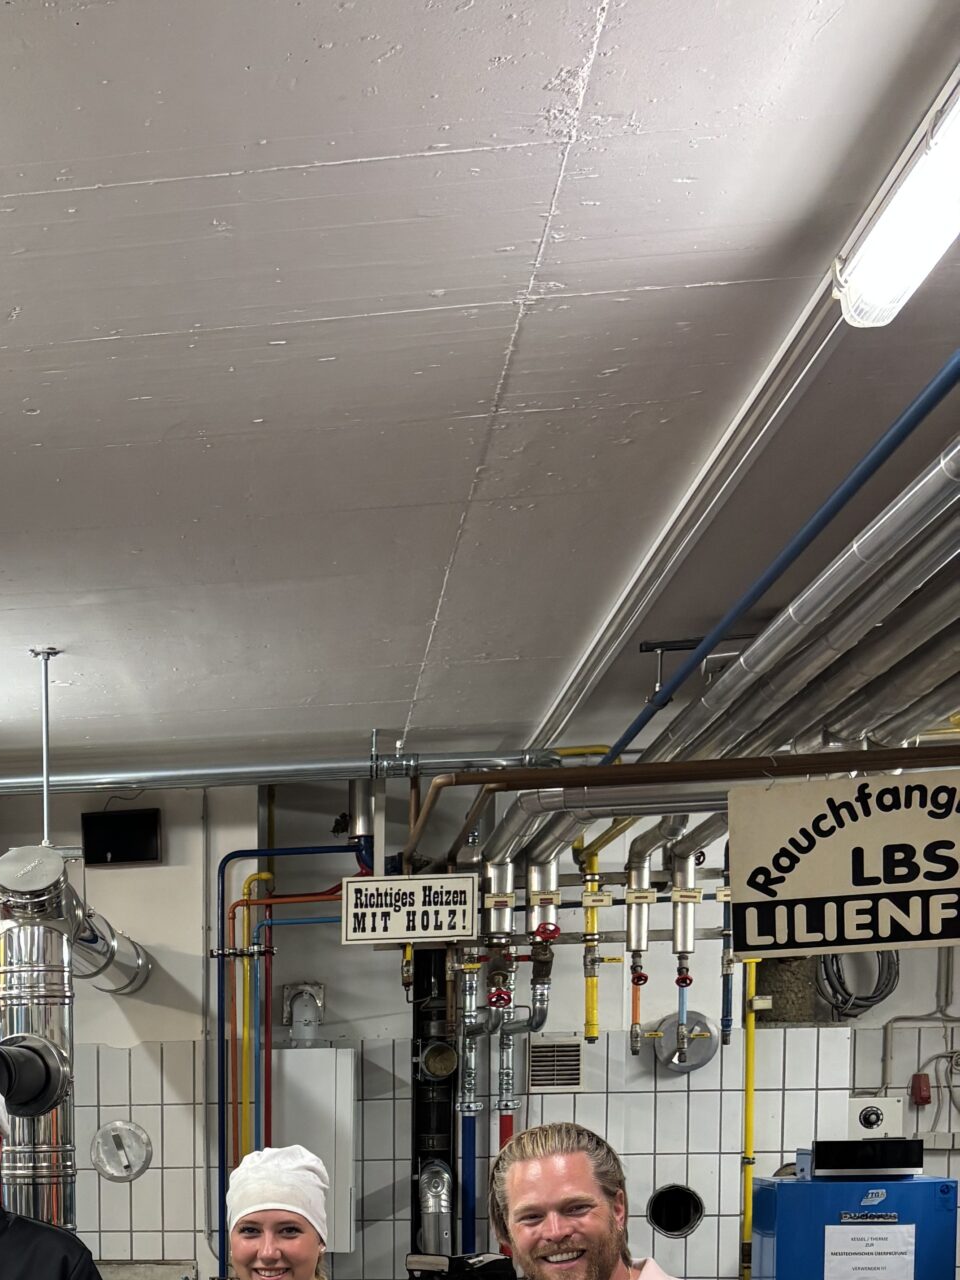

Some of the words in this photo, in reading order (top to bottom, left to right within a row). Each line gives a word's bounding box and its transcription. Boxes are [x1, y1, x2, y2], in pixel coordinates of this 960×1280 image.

[746, 783, 960, 898] Rauchfang
[851, 840, 959, 887] LBS
[352, 911, 391, 933] MIT
[406, 909, 467, 931] HOLZ!
[354, 887, 415, 912] Richtiges
[422, 885, 467, 906] Heizen
[745, 893, 960, 946] LILIENF
